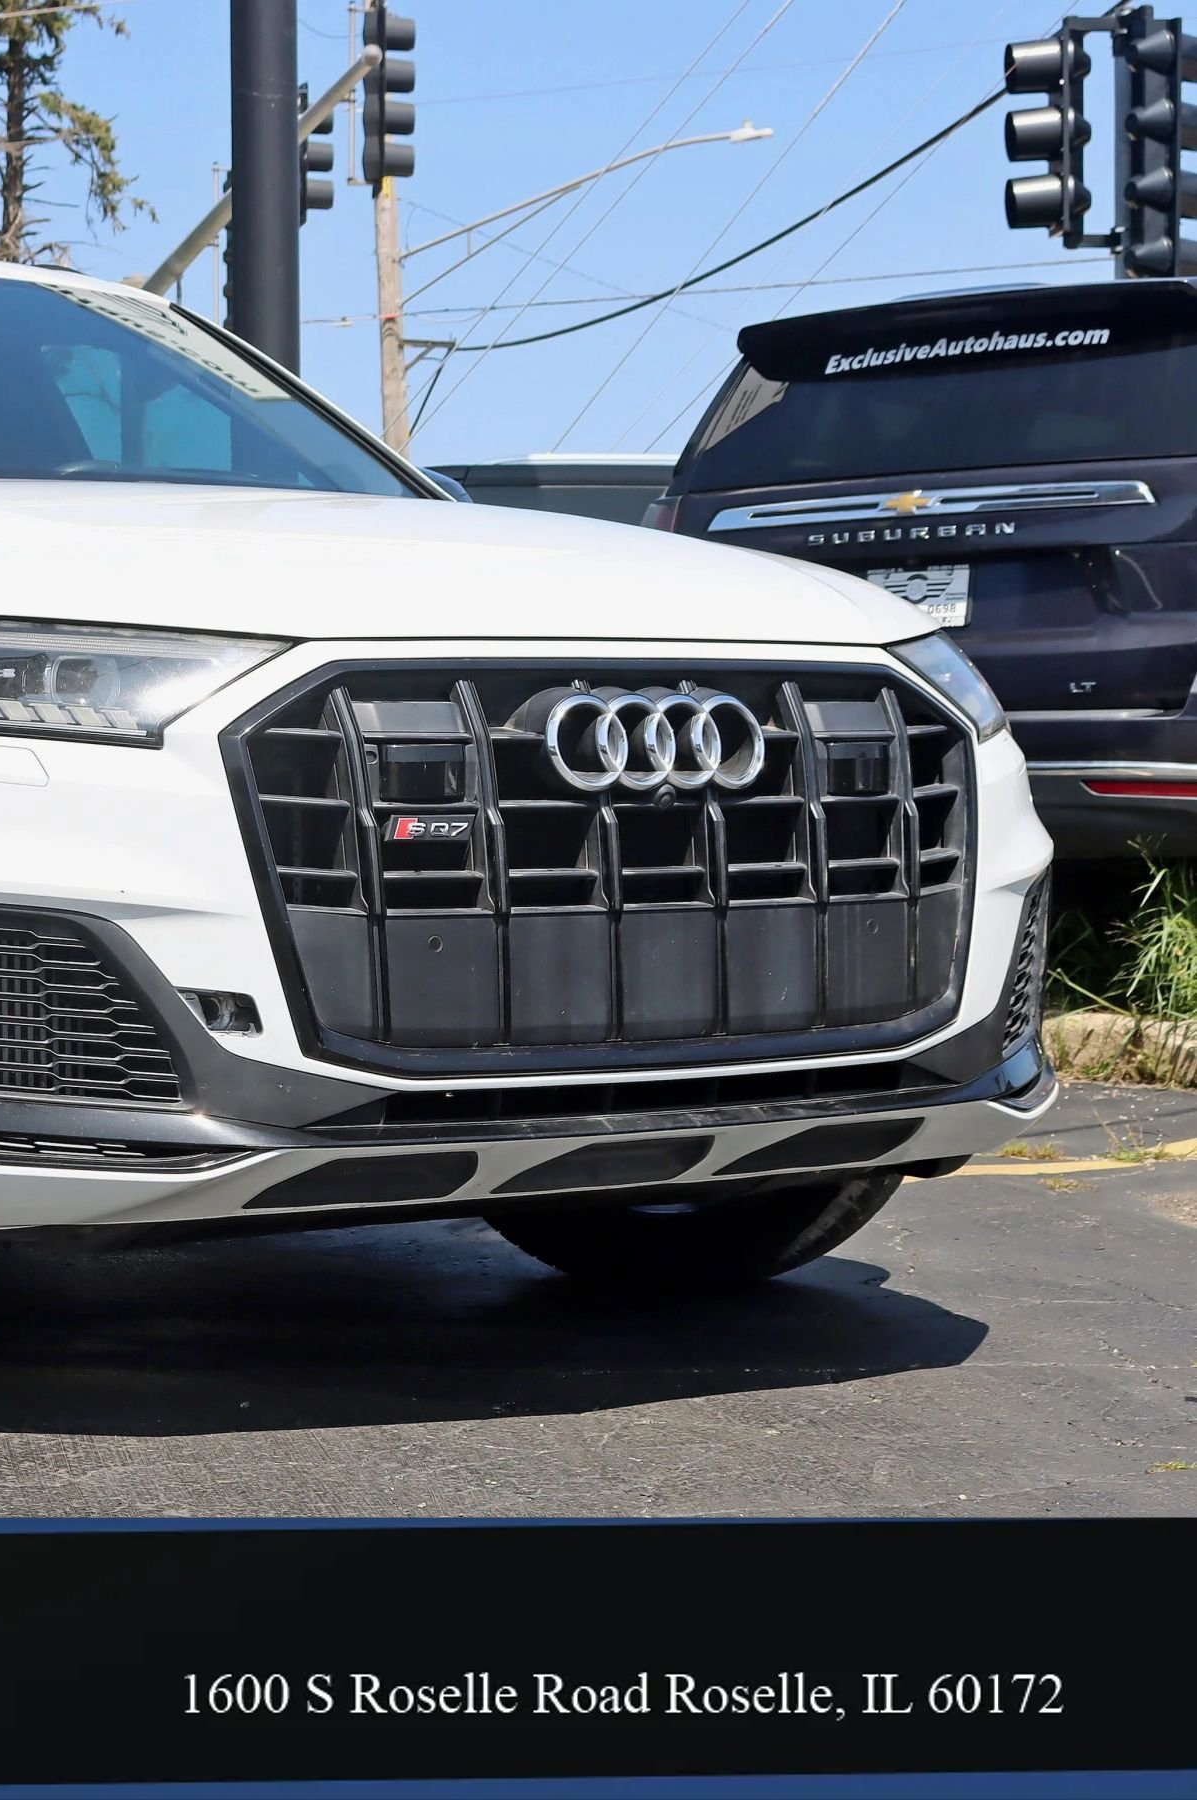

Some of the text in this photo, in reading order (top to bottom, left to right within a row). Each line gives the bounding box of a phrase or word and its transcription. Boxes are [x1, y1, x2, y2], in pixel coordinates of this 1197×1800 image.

[824, 328, 1111, 375] ExclusiveAutohaus.com
[807, 521, 1016, 547] SUBURBAN
[1069, 681, 1097, 693] LT
[405, 821, 470, 838] SQ7
